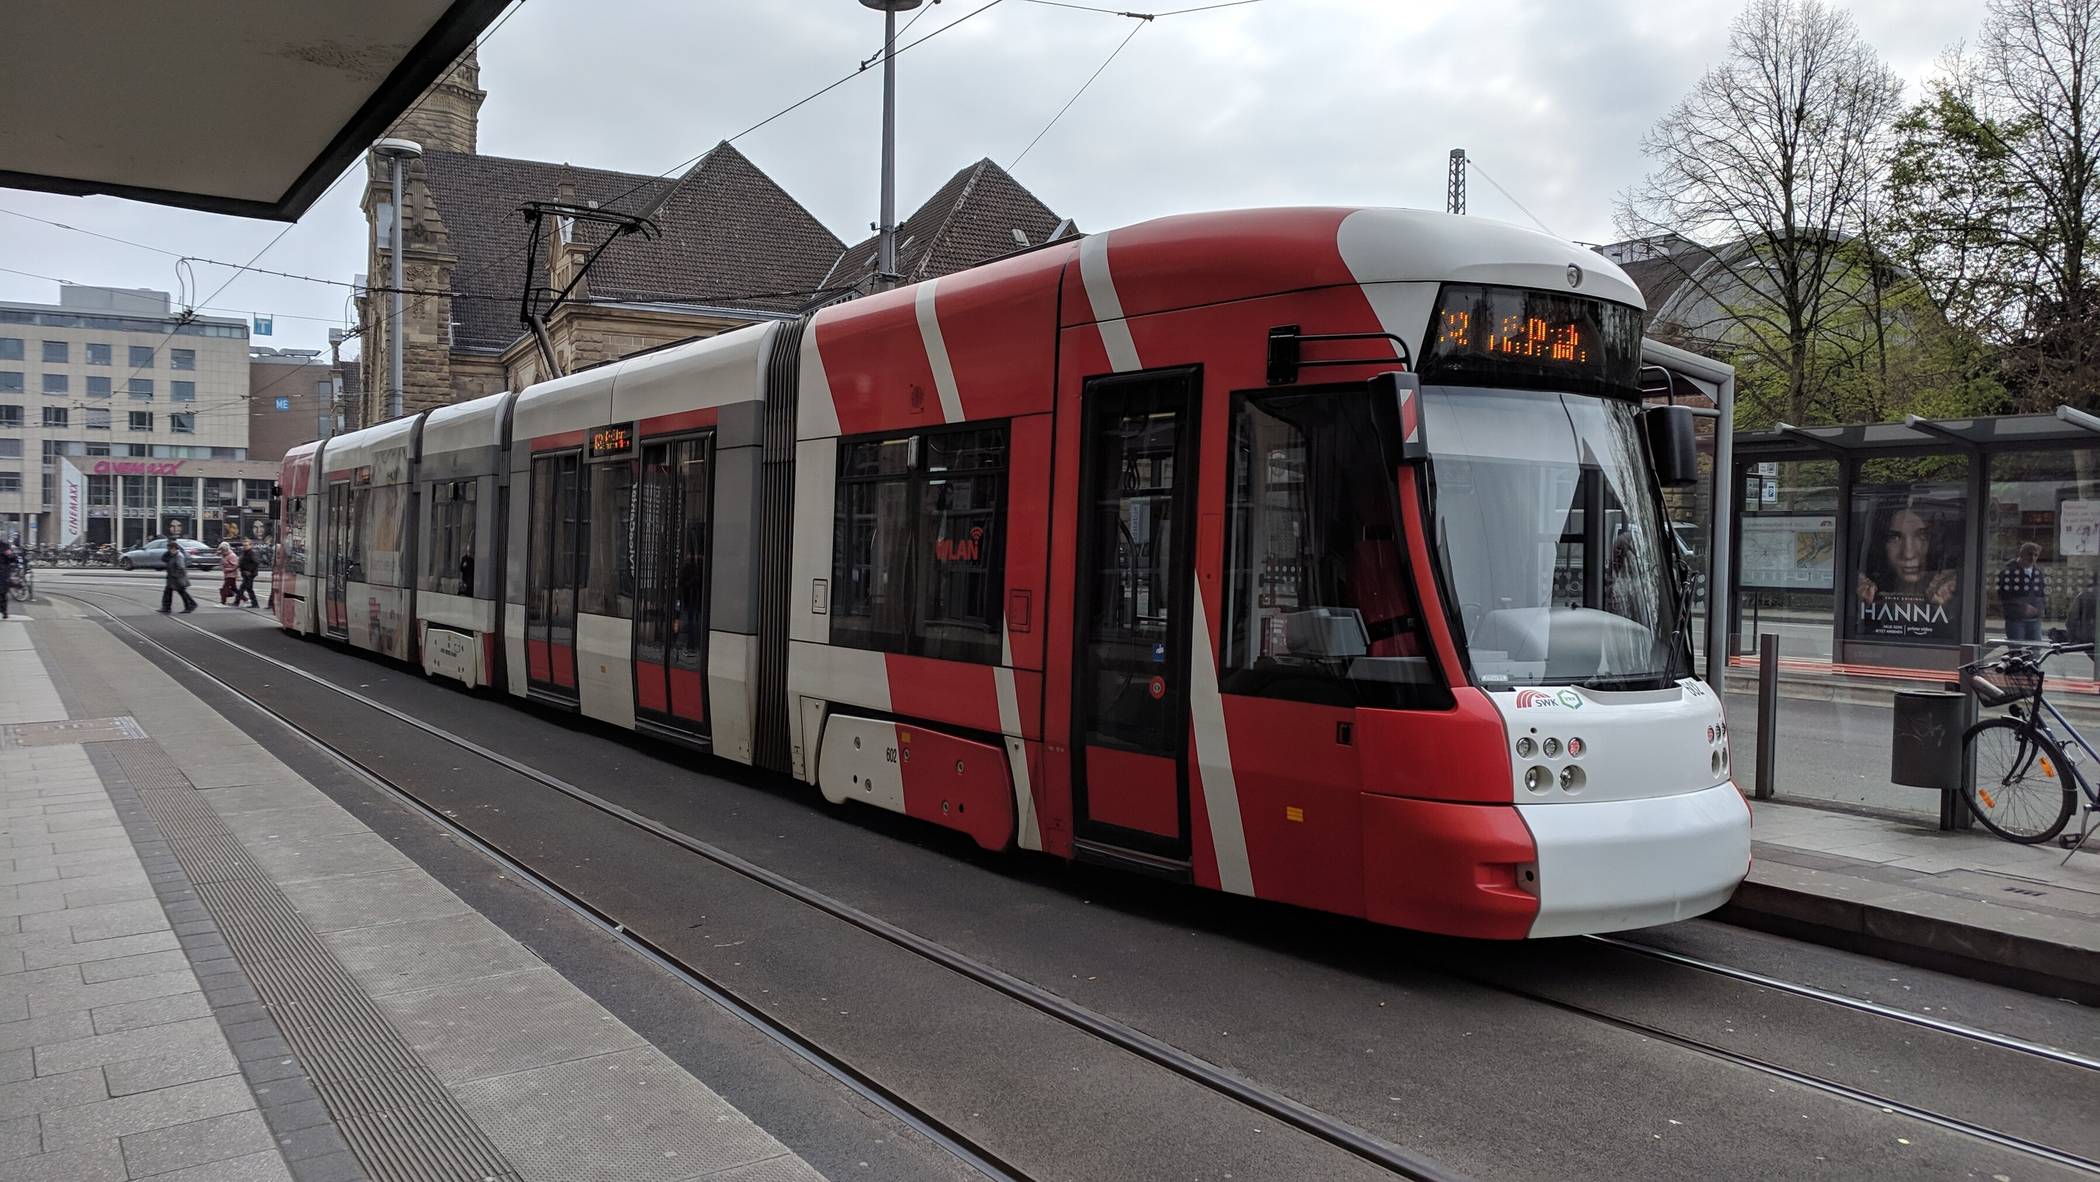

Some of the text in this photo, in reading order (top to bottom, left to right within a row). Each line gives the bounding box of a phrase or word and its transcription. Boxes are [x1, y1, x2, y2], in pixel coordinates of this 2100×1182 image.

[67, 480, 79, 535] CINEMAXX
[936, 538, 978, 561] WLAN
[1861, 602, 1949, 624] HANNA
[1535, 698, 1559, 708] SWK
[886, 746, 897, 764] 602
